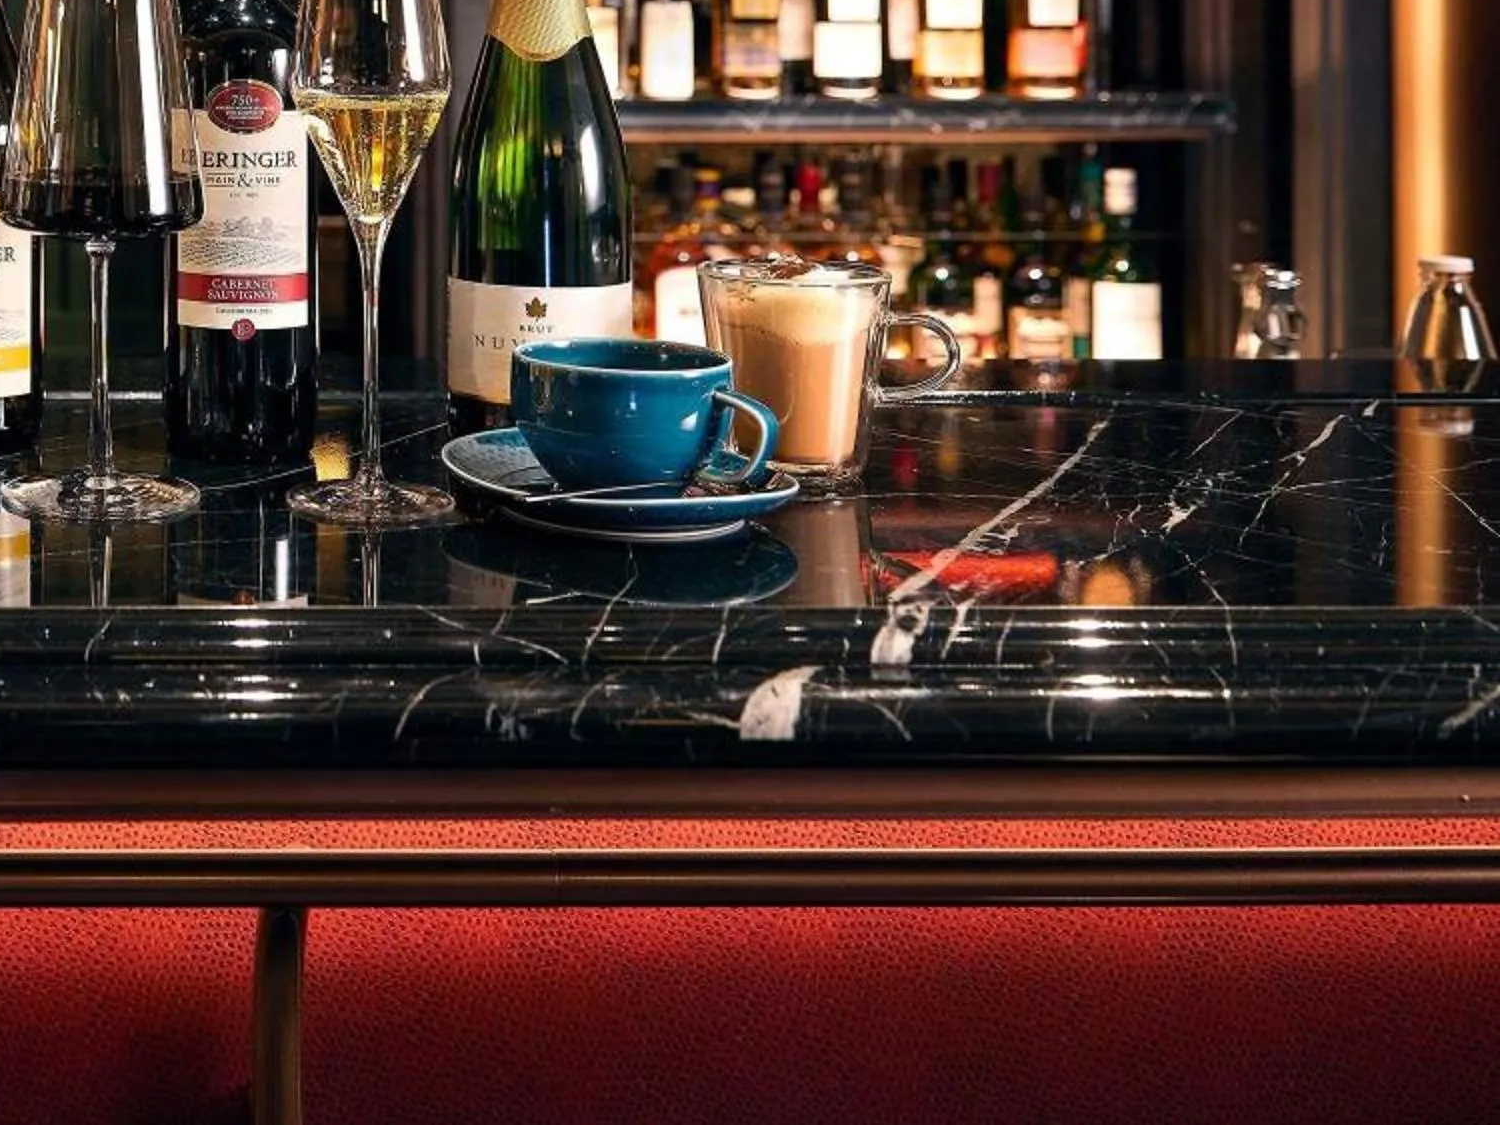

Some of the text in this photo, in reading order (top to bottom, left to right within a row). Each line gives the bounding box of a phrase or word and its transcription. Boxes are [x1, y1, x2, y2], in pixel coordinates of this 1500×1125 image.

[201, 150, 298, 168] ERINGER
[211, 278, 275, 290] CABERNET
[207, 289, 279, 301] SAUVIGNON
[519, 325, 554, 333] BRUT
